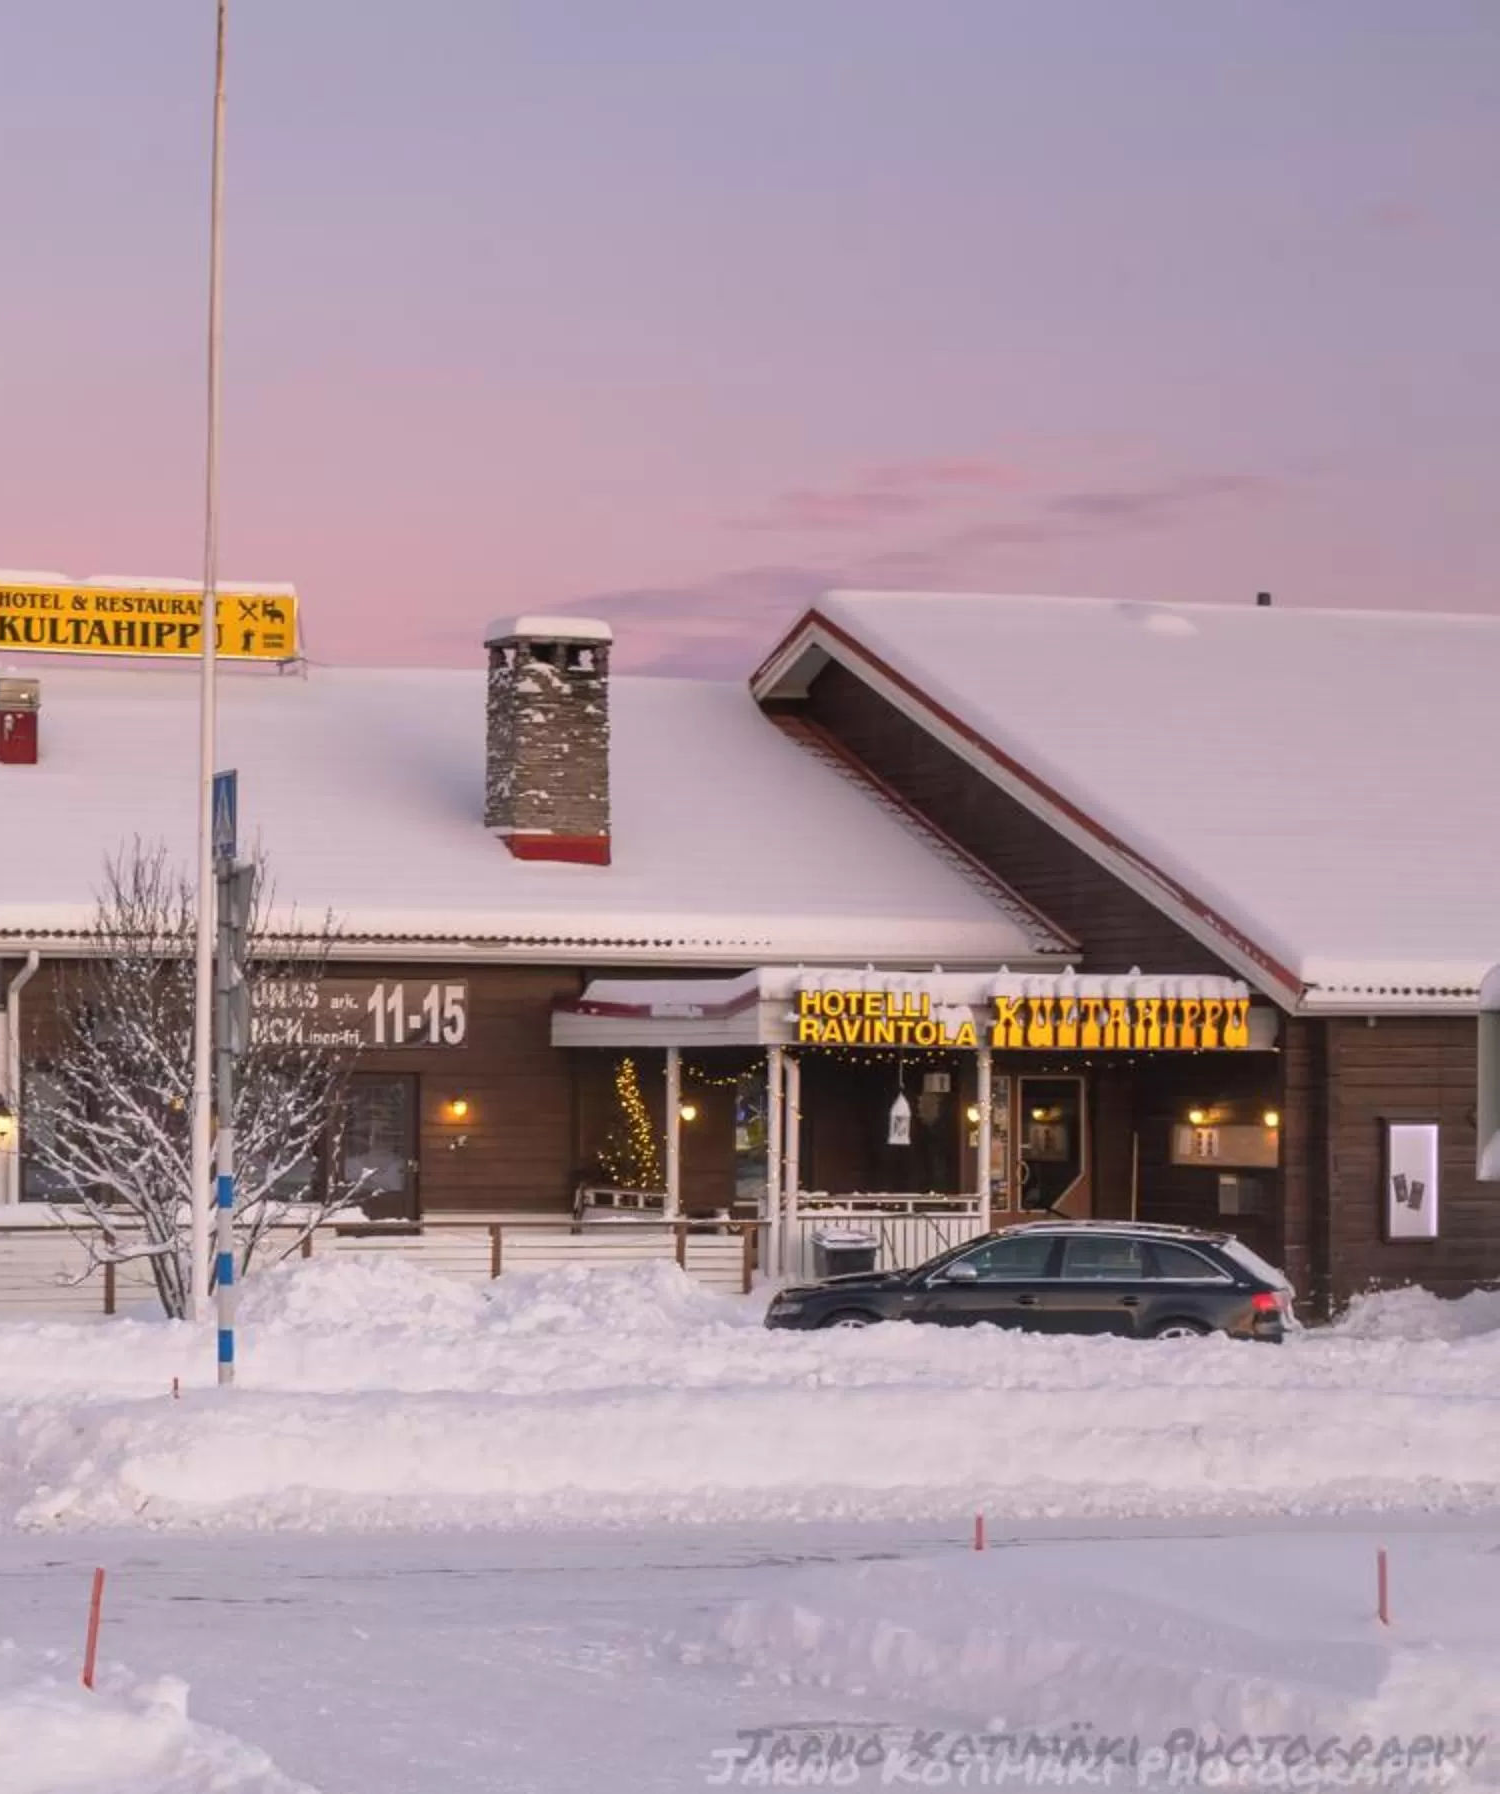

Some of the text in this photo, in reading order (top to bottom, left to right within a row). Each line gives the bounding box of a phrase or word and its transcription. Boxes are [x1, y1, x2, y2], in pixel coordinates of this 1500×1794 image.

[71, 594, 88, 611] &
[367, 983, 467, 1046] 11-15
[799, 990, 931, 1018] HOTELLI
[799, 1018, 980, 1047] RAVINTOLA
[992, 996, 1247, 1048] KULTAHIPPU
